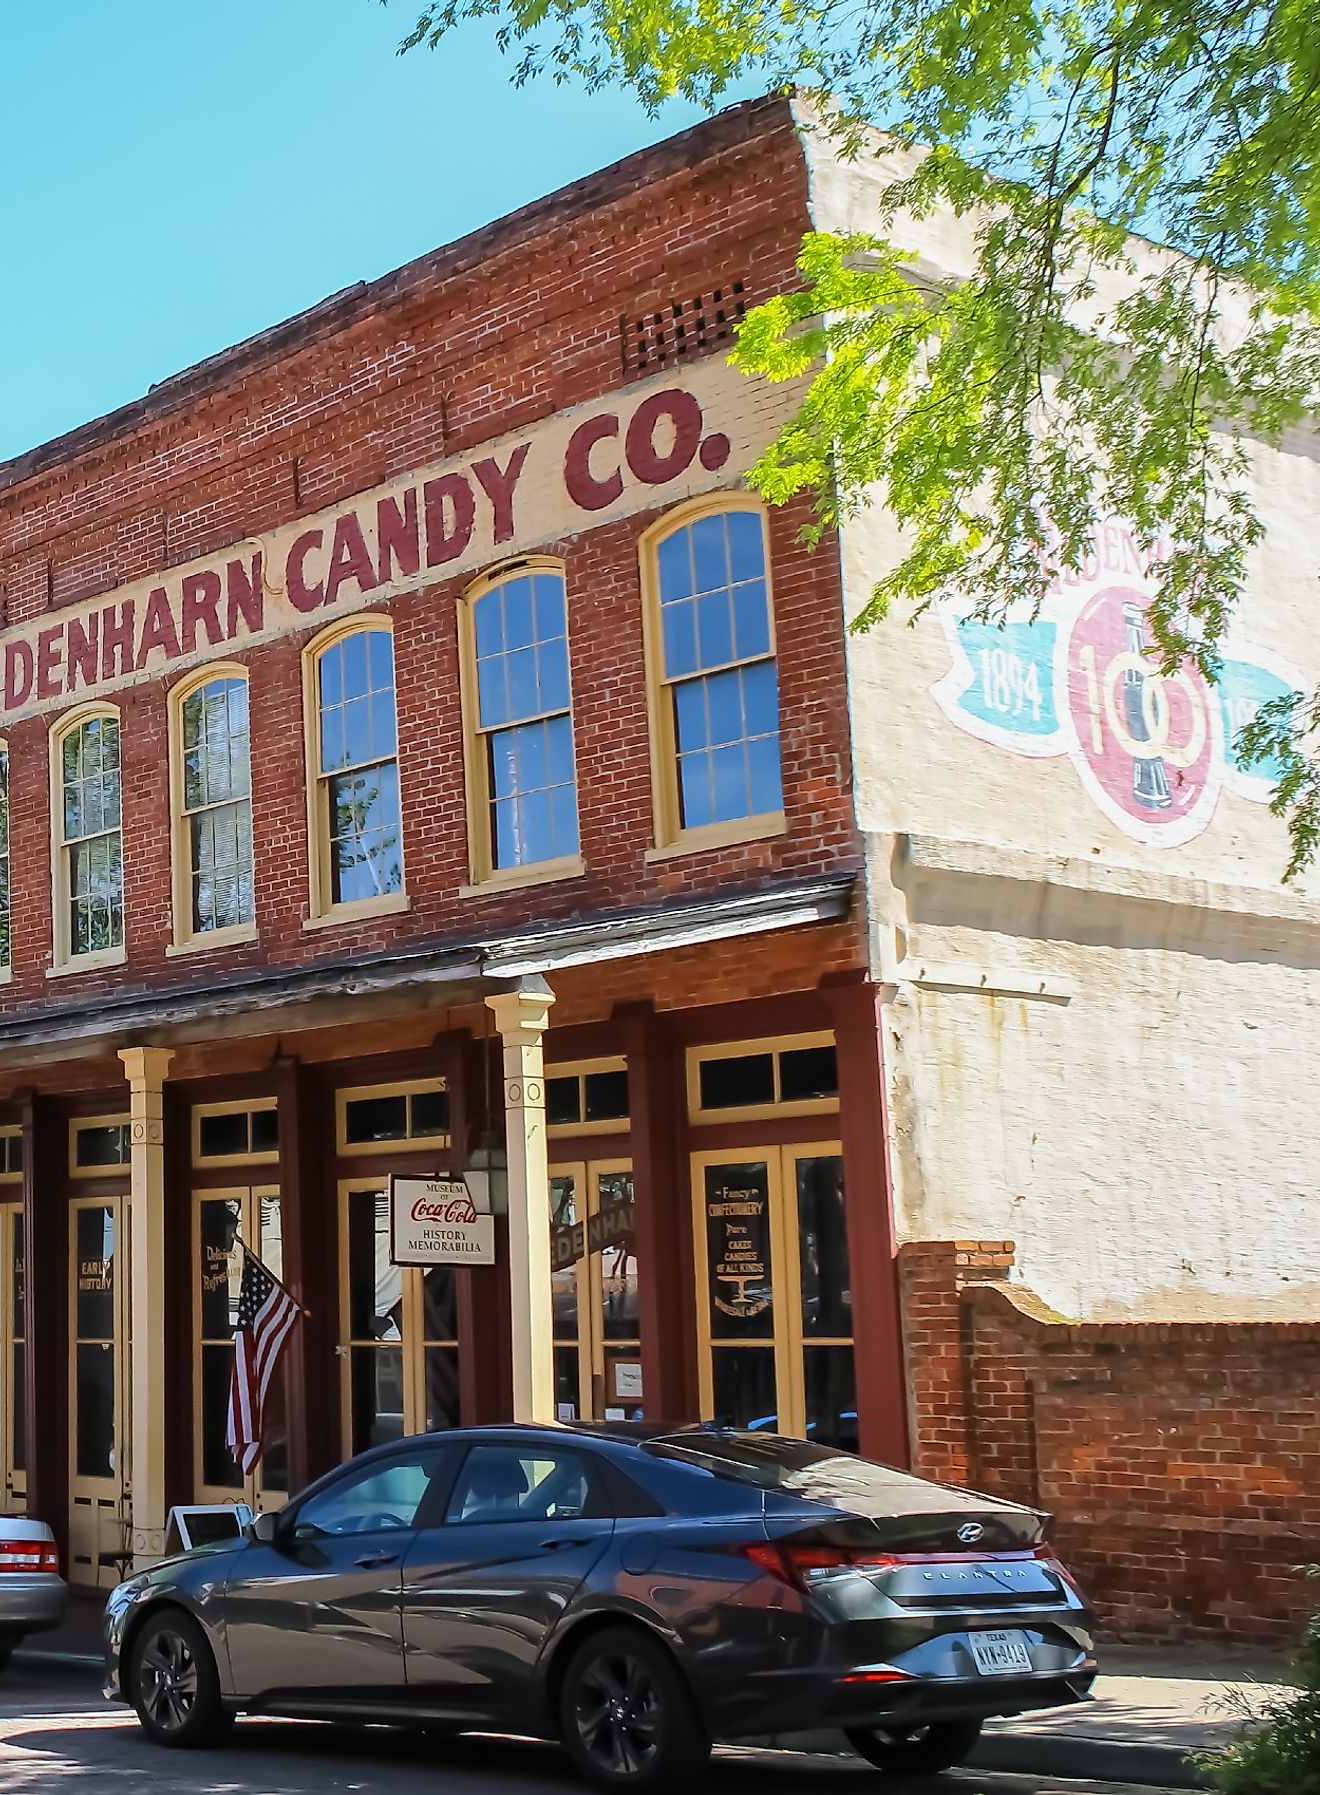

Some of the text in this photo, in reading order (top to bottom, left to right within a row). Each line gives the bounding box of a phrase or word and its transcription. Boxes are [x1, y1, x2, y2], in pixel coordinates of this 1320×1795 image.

[285, 441, 532, 613] CANDY
[564, 388, 730, 511] CO.
[981, 648, 1043, 722] 1894
[426, 1184, 463, 1194] MUSEUM
[423, 1229, 466, 1240] HISTORY
[408, 1240, 482, 1253] MEMORABILIA
[82, 1261, 111, 1276] EARLY
[923, 1569, 1027, 1580] ELANTRA
[986, 1632, 1007, 1642] TEXAS
